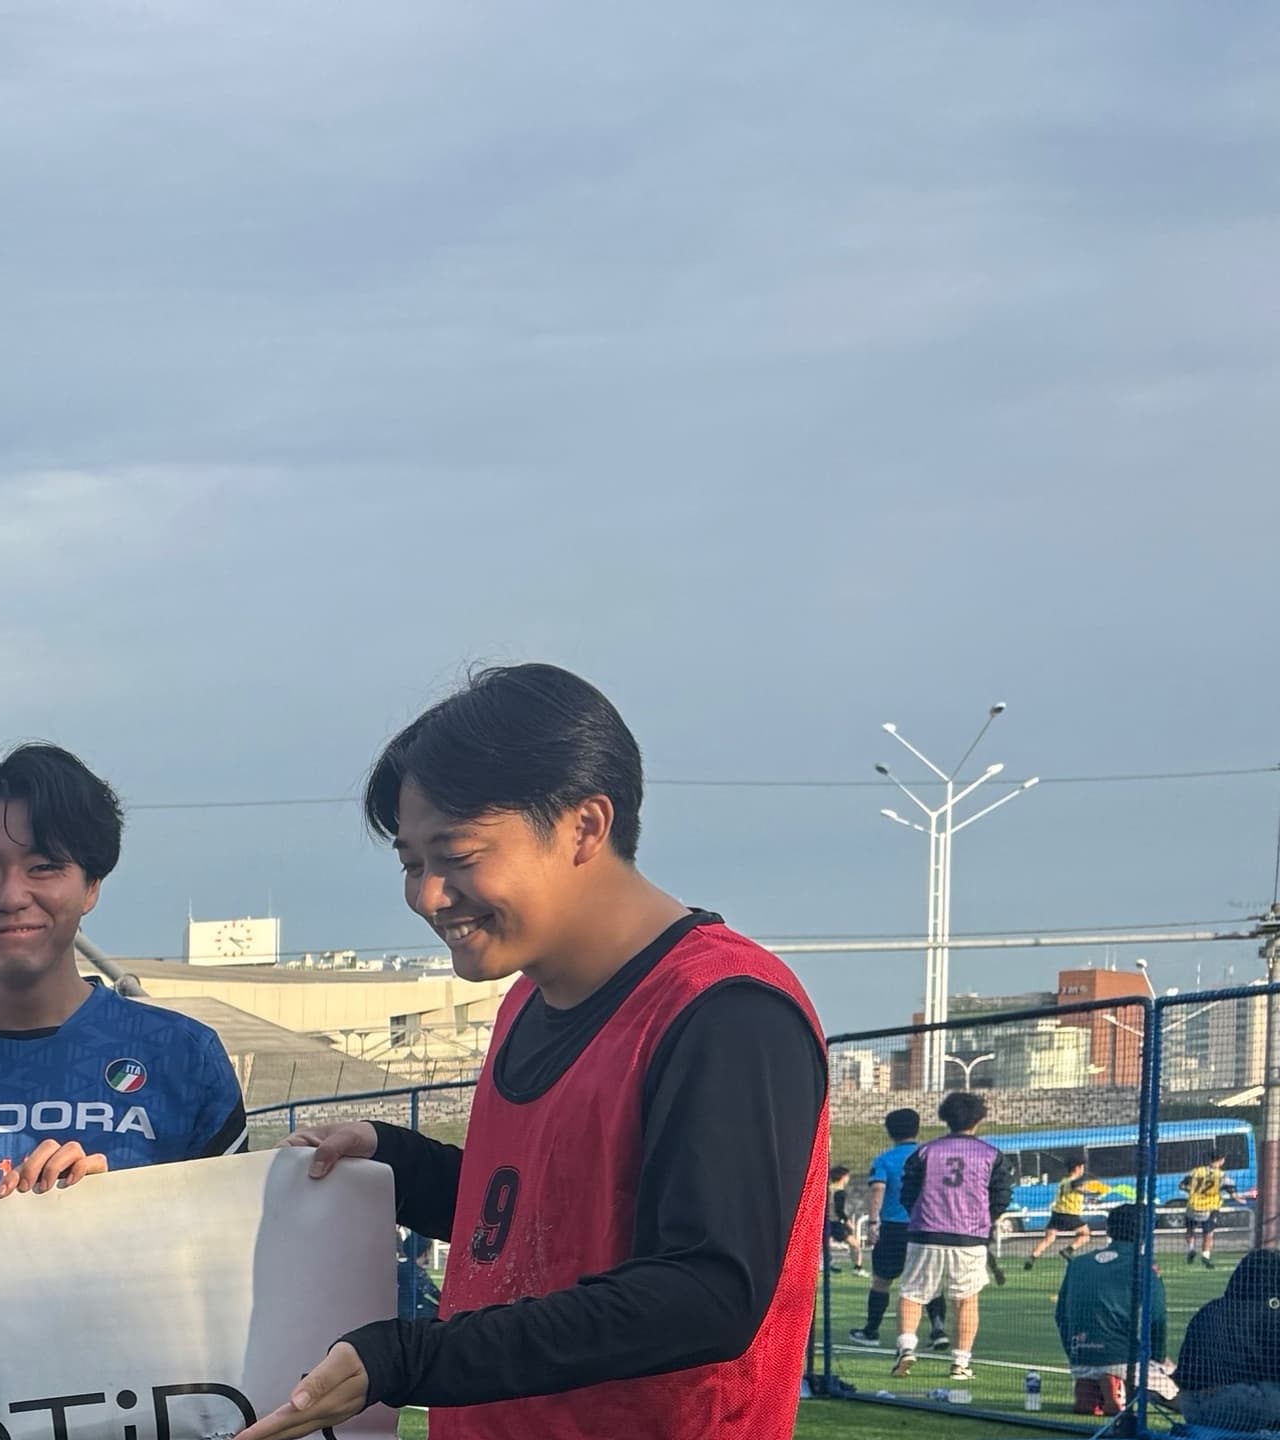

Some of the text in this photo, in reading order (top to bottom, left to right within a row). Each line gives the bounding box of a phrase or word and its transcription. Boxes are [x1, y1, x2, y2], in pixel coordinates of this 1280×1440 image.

[126, 1064, 141, 1075] ITA
[942, 1156, 964, 1187] 3
[471, 1166, 520, 1264] 9
